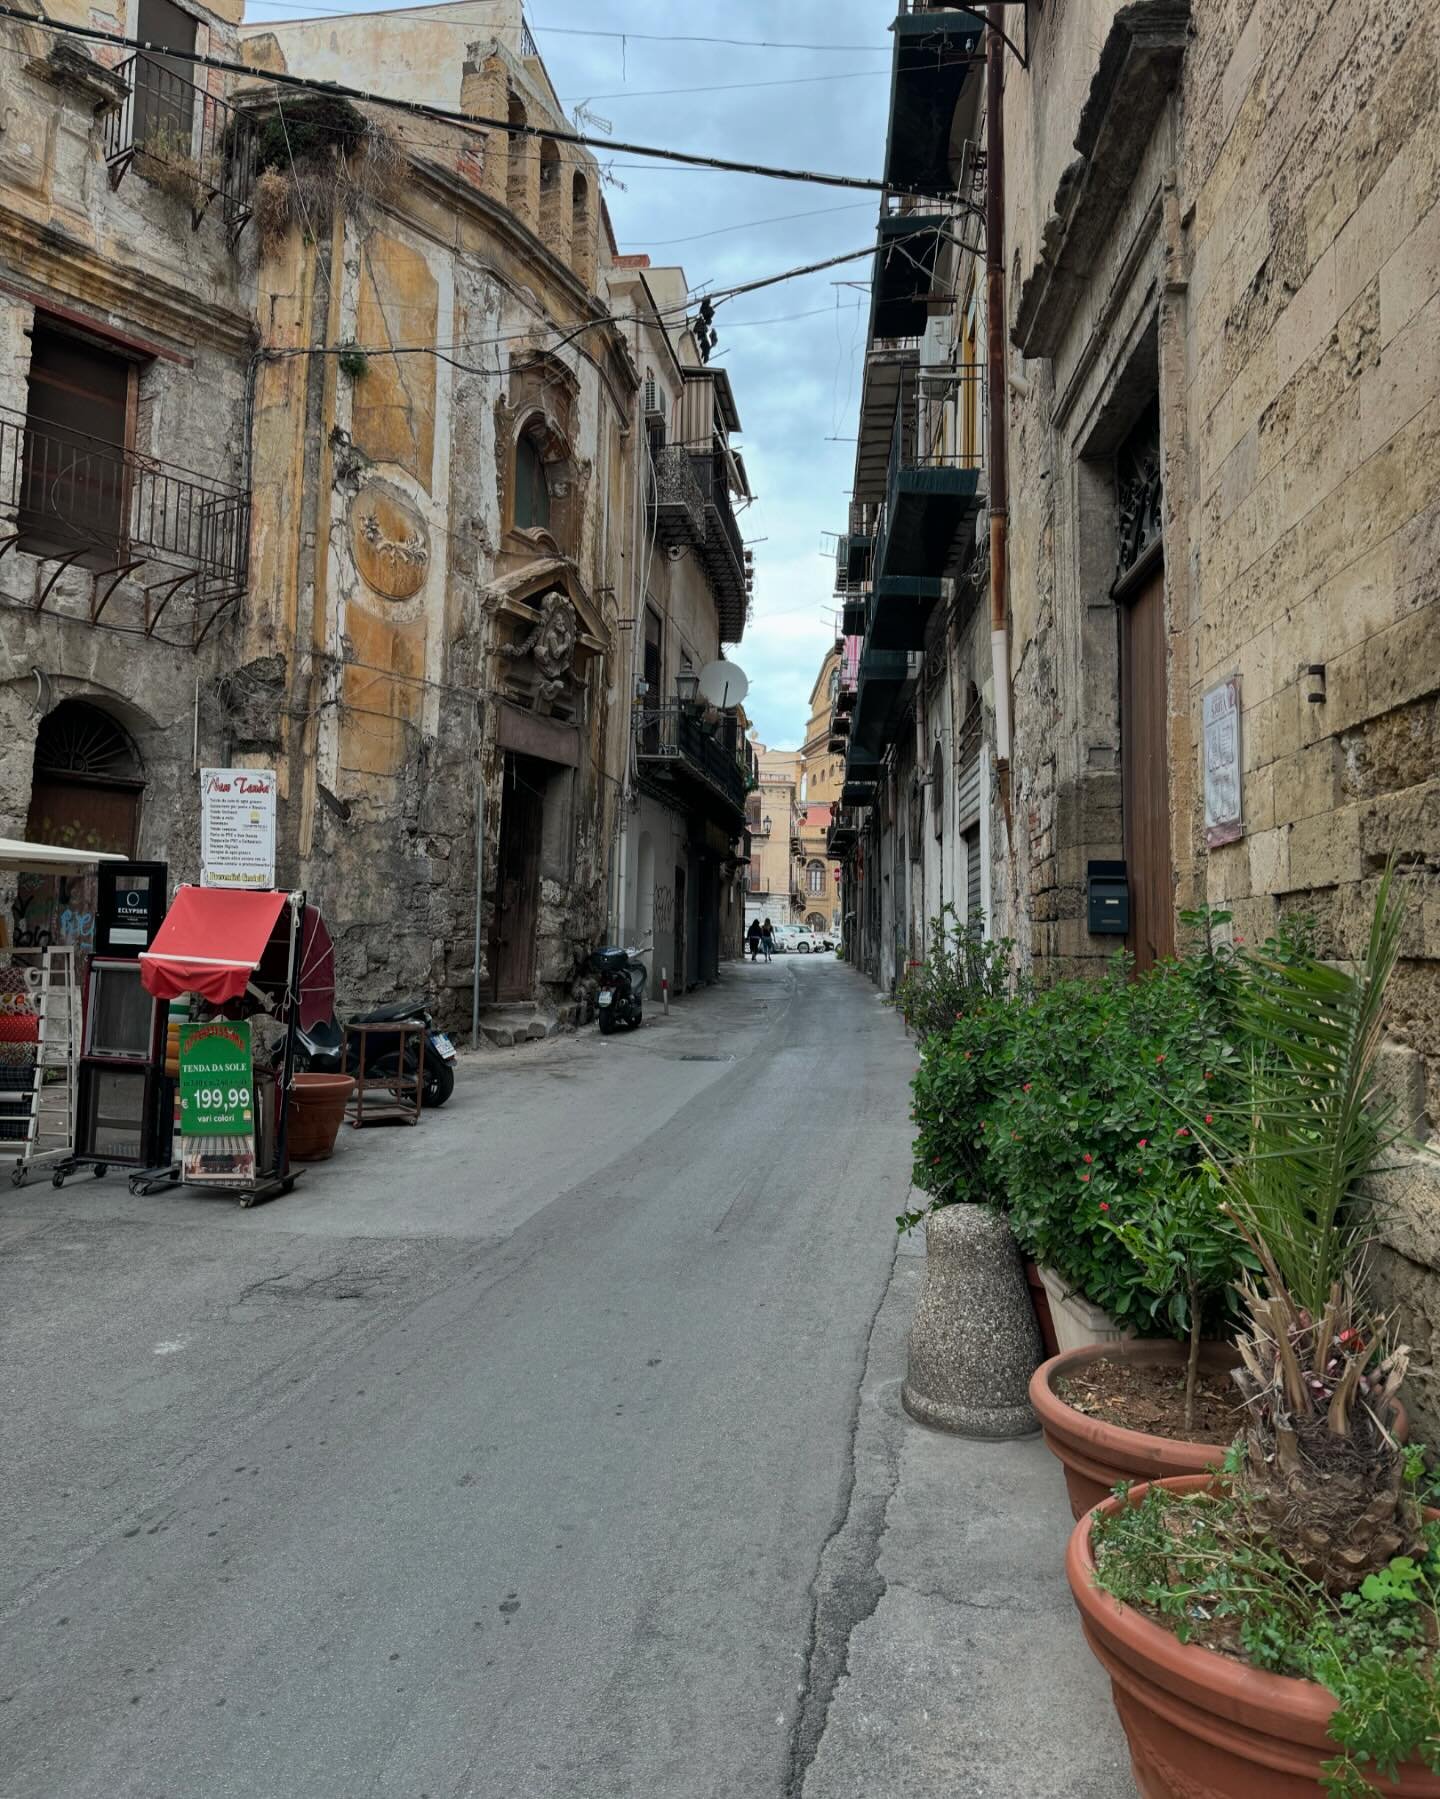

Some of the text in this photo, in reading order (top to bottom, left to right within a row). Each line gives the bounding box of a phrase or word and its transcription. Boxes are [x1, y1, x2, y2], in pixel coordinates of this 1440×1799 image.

[234, 776, 270, 794] Tenda
[182, 1063, 247, 1073] TENDA DA SOLE
[194, 1087, 250, 1113] 199,99
[197, 1113, 235, 1122] vari colori
